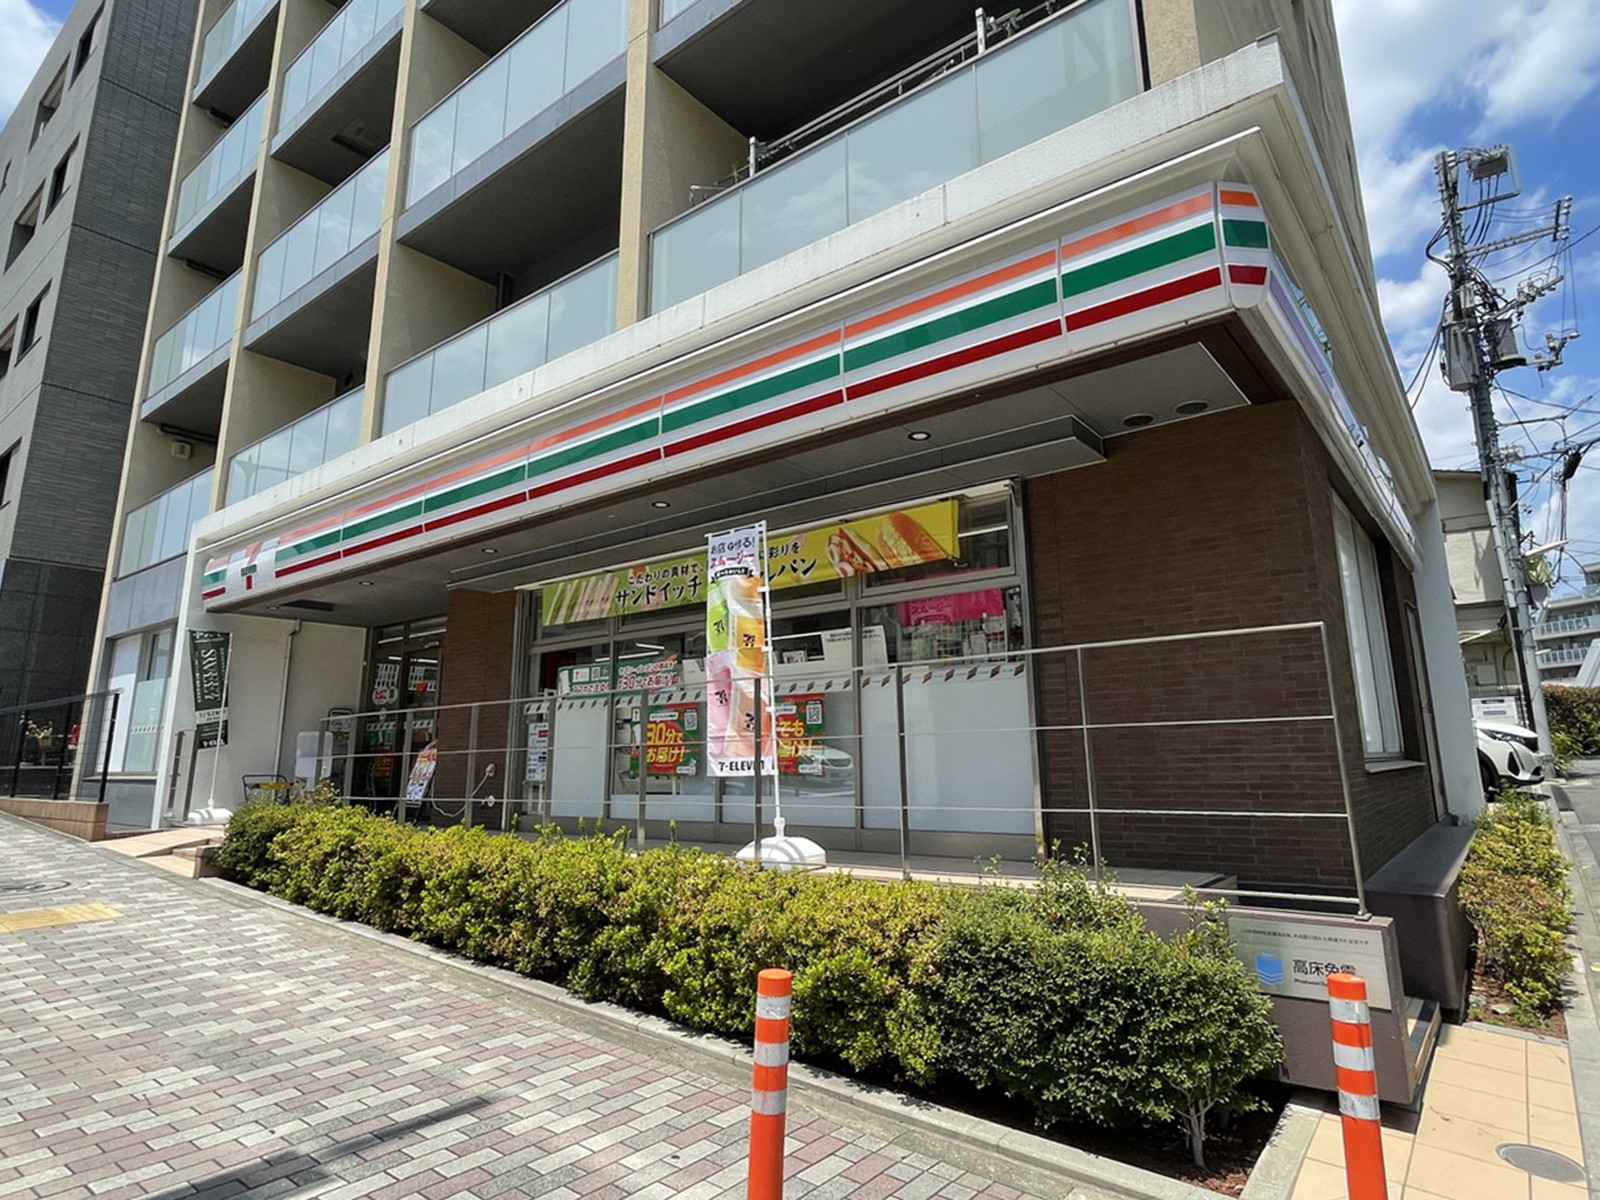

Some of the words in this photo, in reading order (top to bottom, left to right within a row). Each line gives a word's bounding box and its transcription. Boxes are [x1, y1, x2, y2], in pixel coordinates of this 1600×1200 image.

[616, 575, 702, 608] サンドイッチ
[718, 760, 765, 771] 7-ELEV
